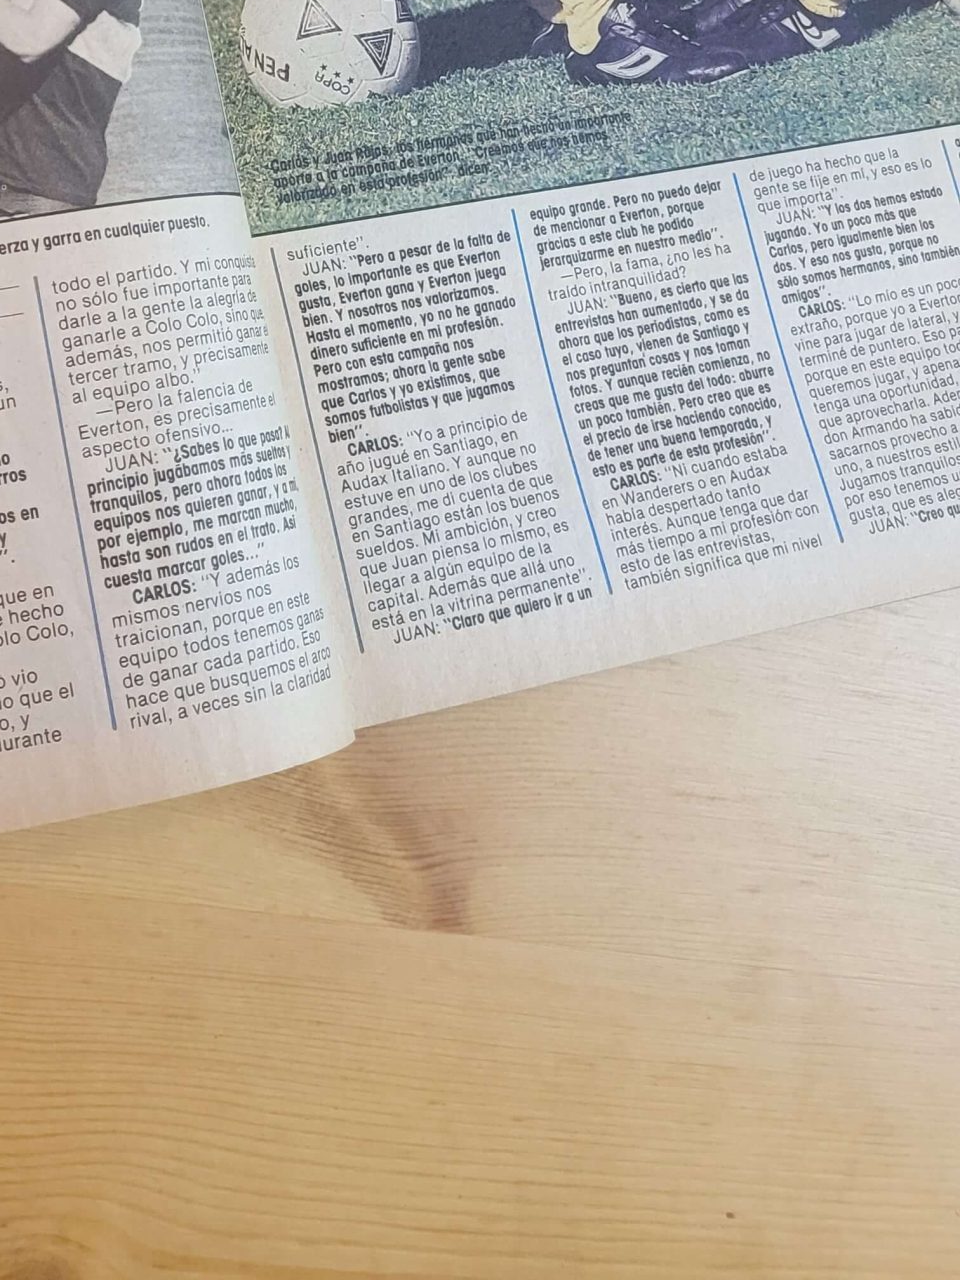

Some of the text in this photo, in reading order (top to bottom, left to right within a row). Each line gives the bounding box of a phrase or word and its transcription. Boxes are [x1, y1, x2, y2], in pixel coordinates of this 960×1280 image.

[315, 71, 351, 95] COPA
[749, 148, 900, 183] de juego ha hecho que la
[529, 180, 721, 222] equipo grande. Pero no puedo dejar
[31, 237, 40, 253] y
[42, 231, 82, 251] garra
[84, 228, 102, 242] en
[104, 218, 165, 239] cualquier
[167, 215, 210, 234] puesto.
[301, 284, 499, 328] bien. Y nosotros nos valorizamos.
[81, 434, 151, 459] aspecto
[624, 533, 823, 591] también significa que mi nivel
[129, 665, 331, 729] rival, a veces sin la claridad
